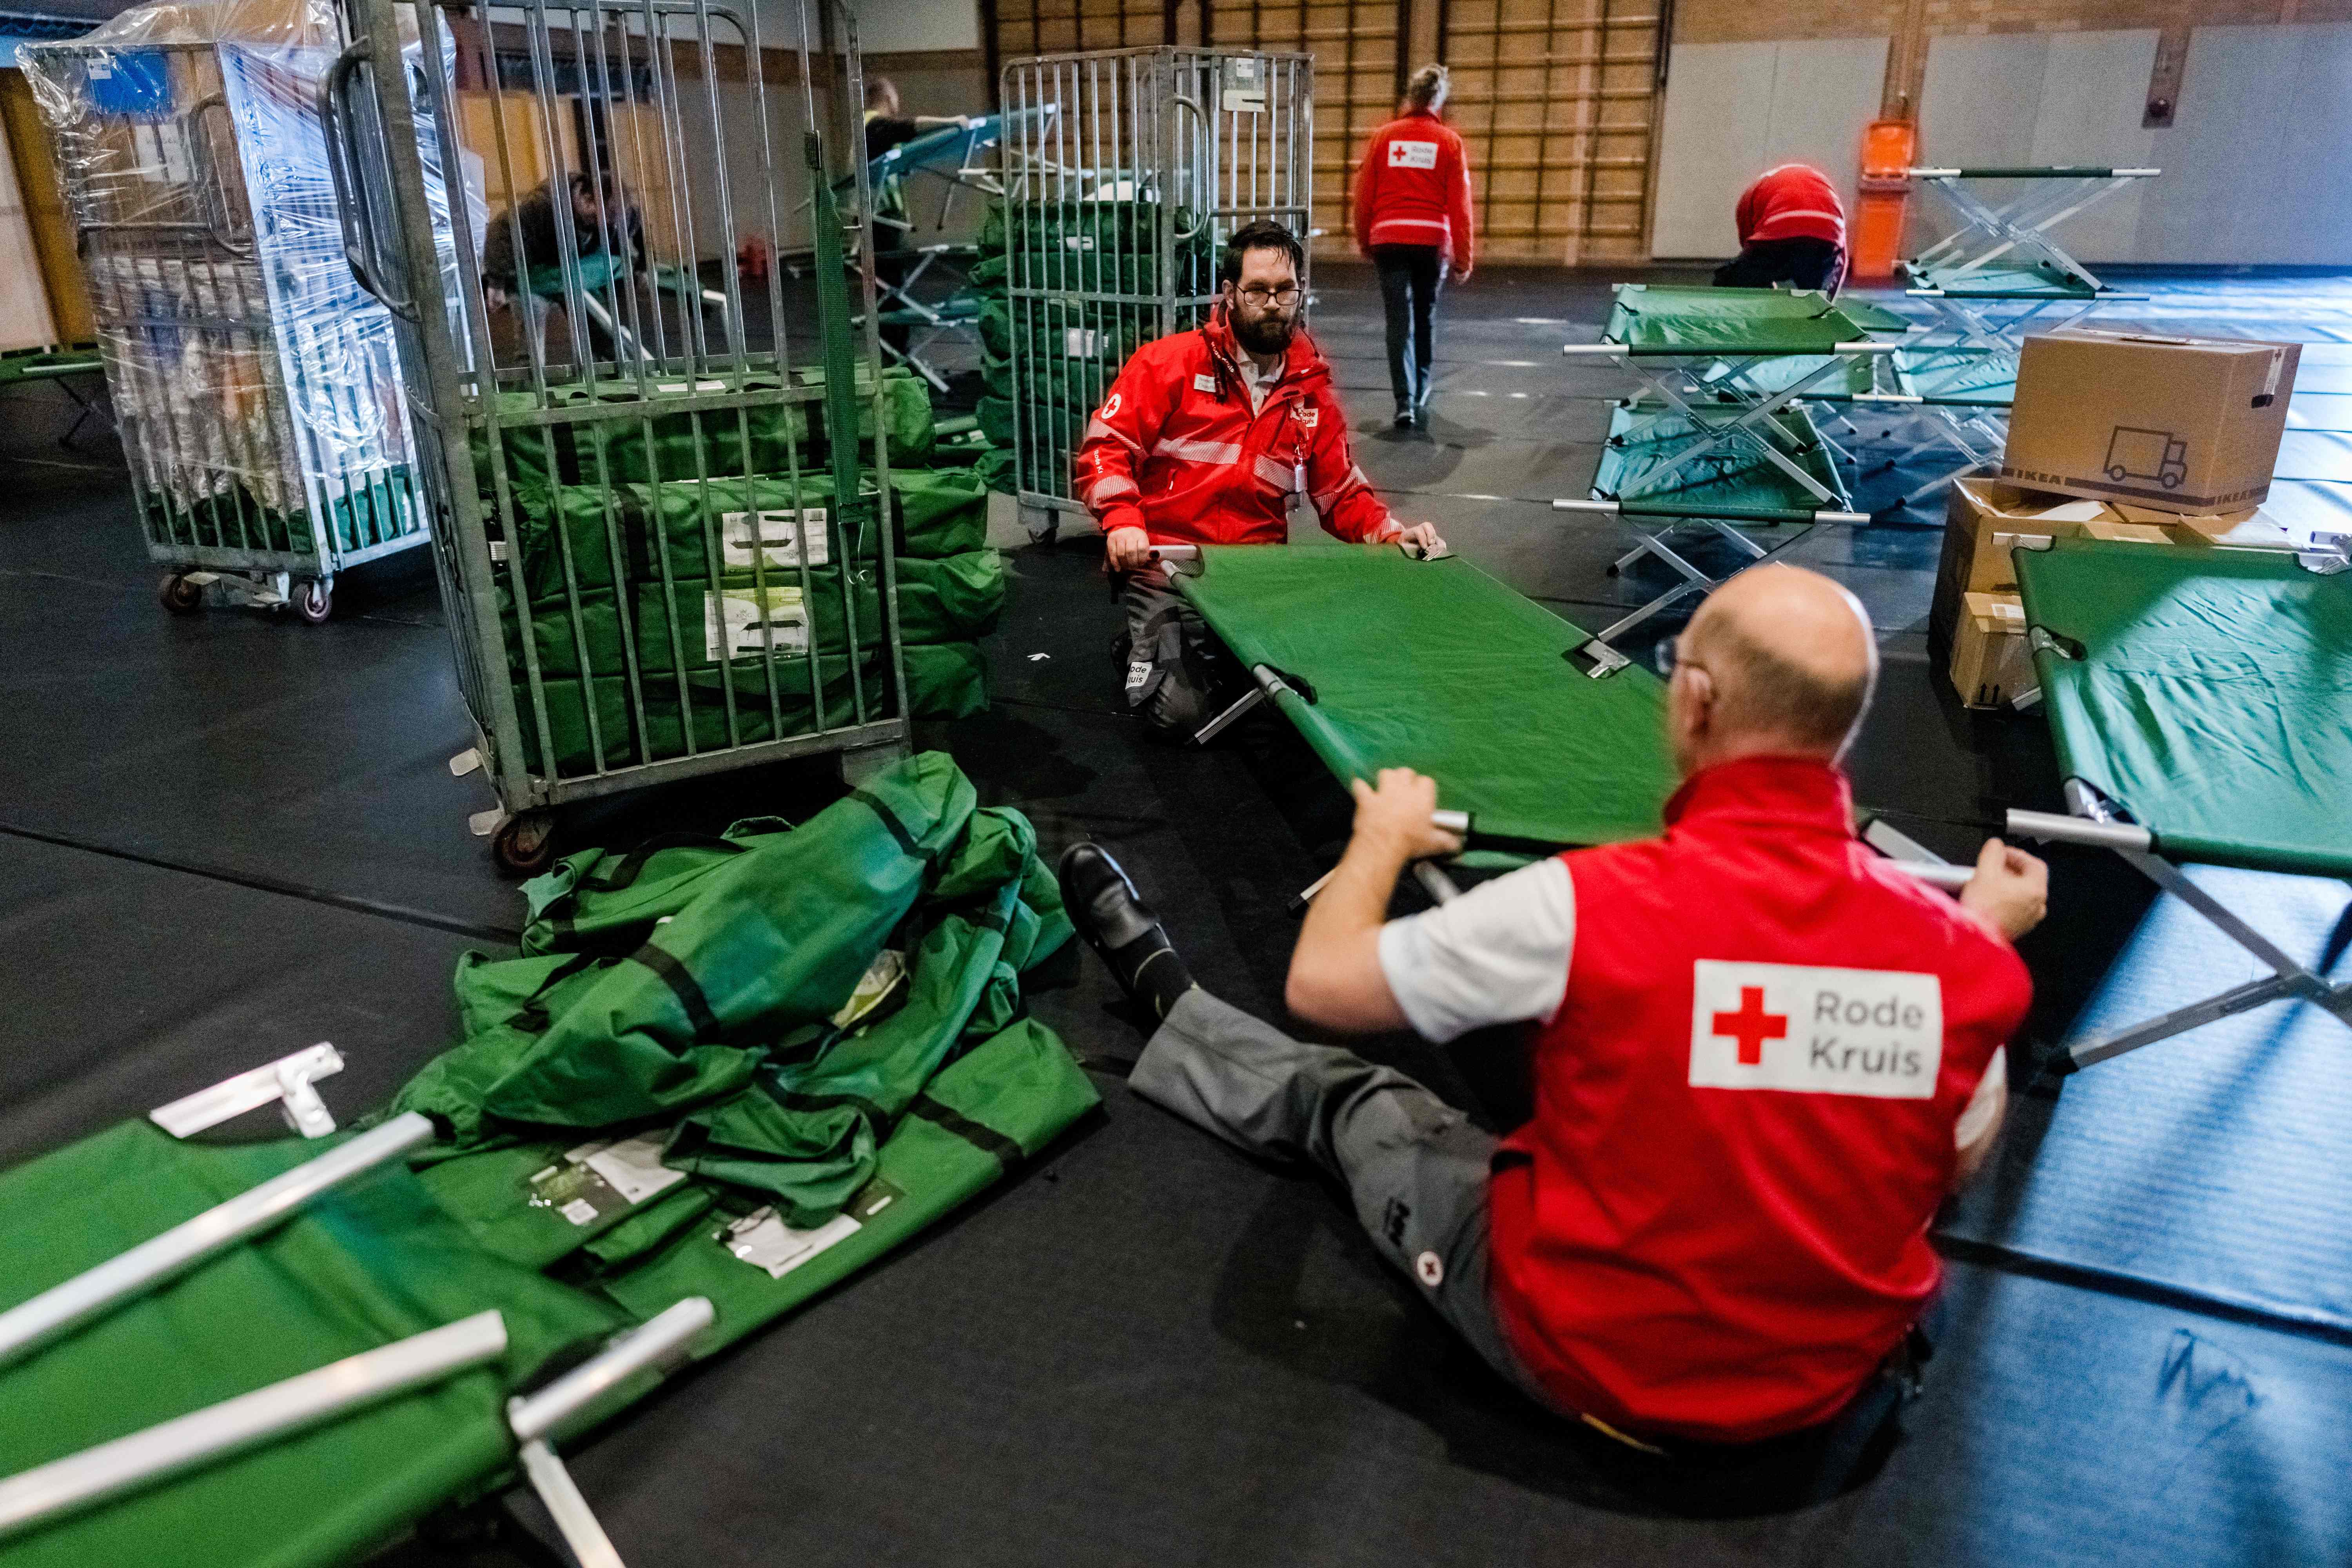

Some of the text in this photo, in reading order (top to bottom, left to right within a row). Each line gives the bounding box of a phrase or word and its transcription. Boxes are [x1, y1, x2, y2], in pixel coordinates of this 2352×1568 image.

[2017, 470, 2061, 485] IKEA
[2216, 490, 2249, 505] IKEA
[1814, 991, 1924, 1029] Rode
[1809, 1036, 1921, 1076] Kruis
